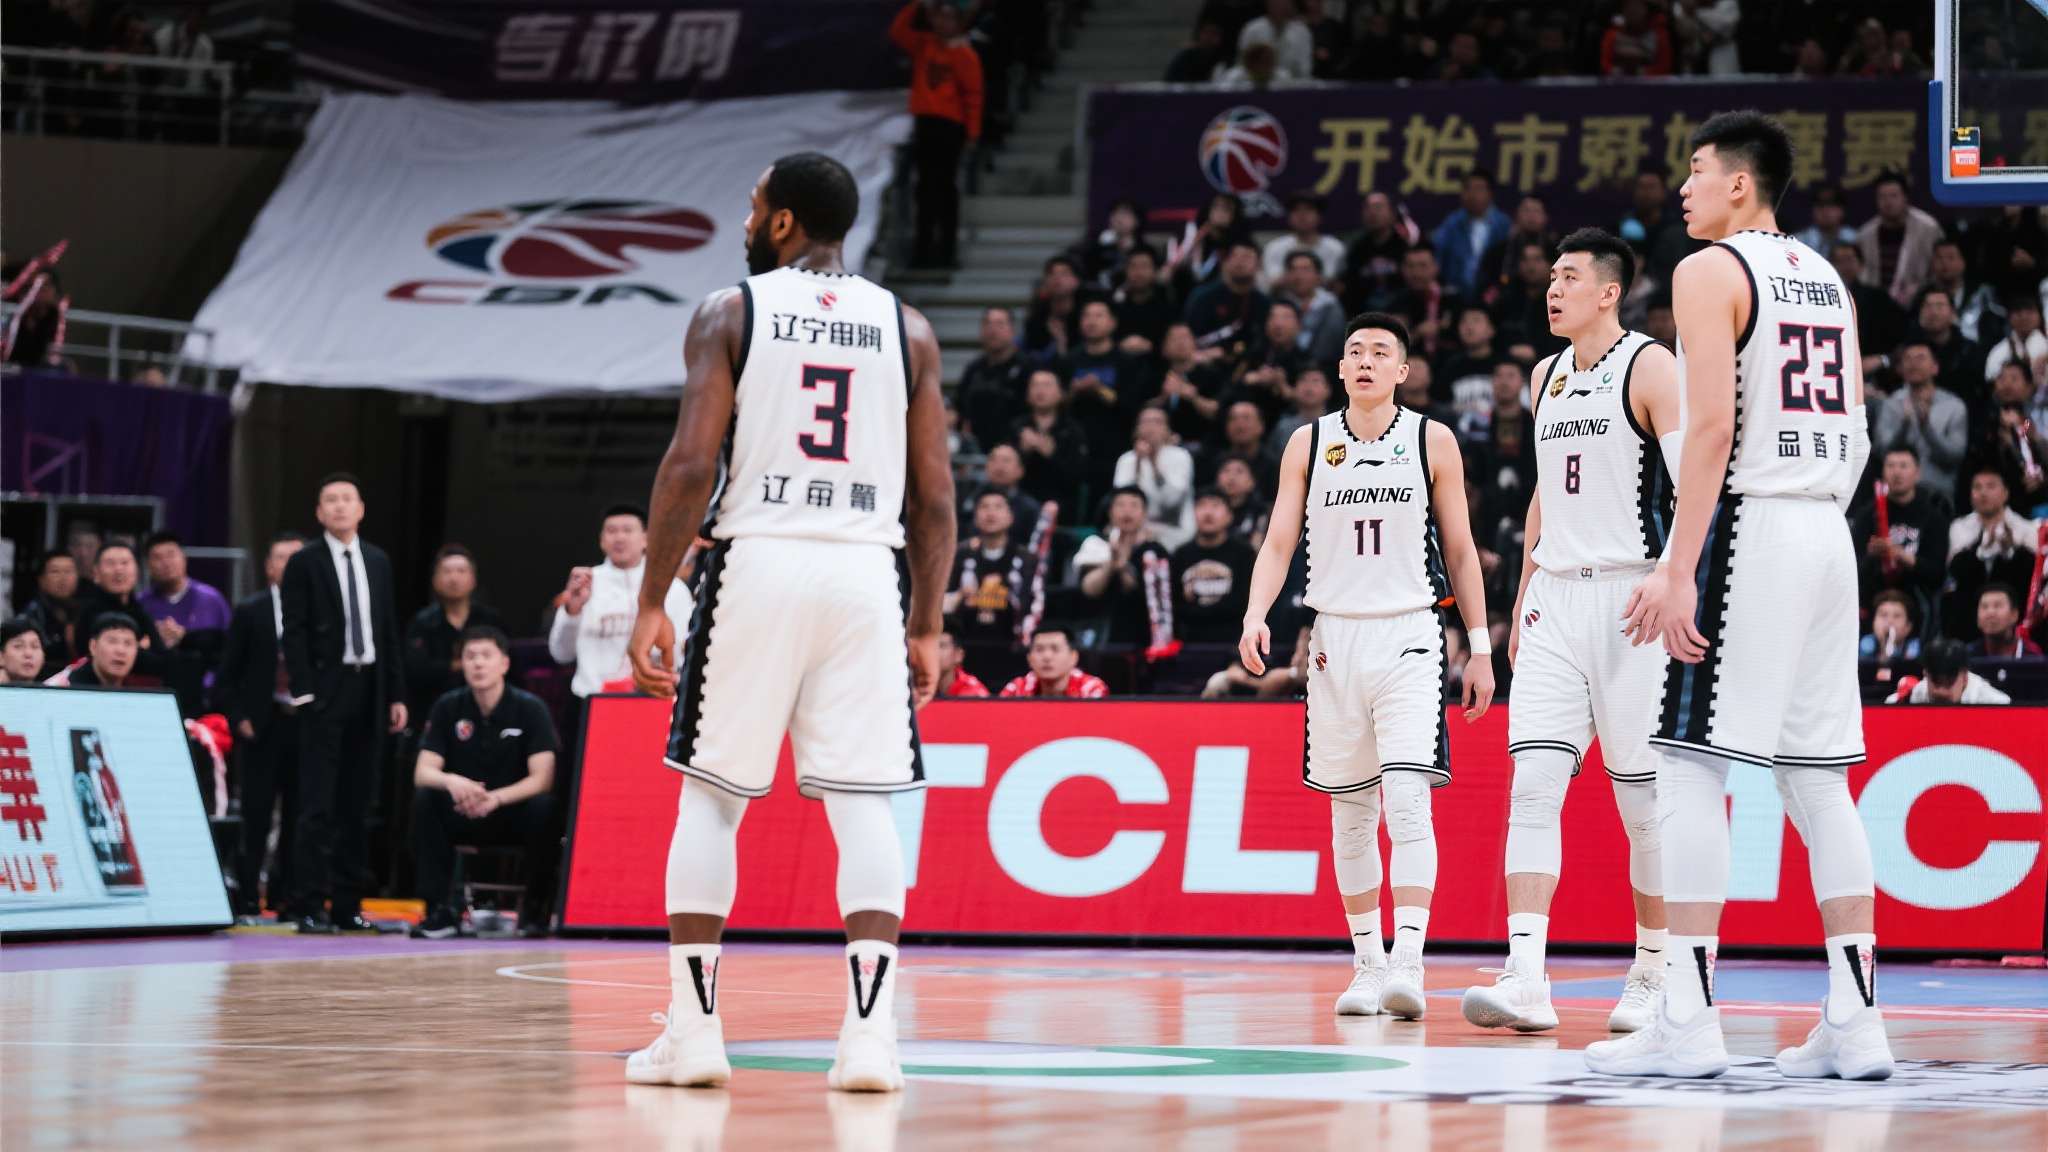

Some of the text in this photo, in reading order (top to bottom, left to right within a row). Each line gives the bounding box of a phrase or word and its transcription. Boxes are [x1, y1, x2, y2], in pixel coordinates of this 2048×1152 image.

[1779, 322, 1848, 415] 23
[797, 363, 855, 463] 3
[1541, 418, 1610, 441] LIAONING
[1565, 454, 1581, 494] 8
[1324, 487, 1413, 507] LIAONING
[1354, 519, 1383, 555] 11
